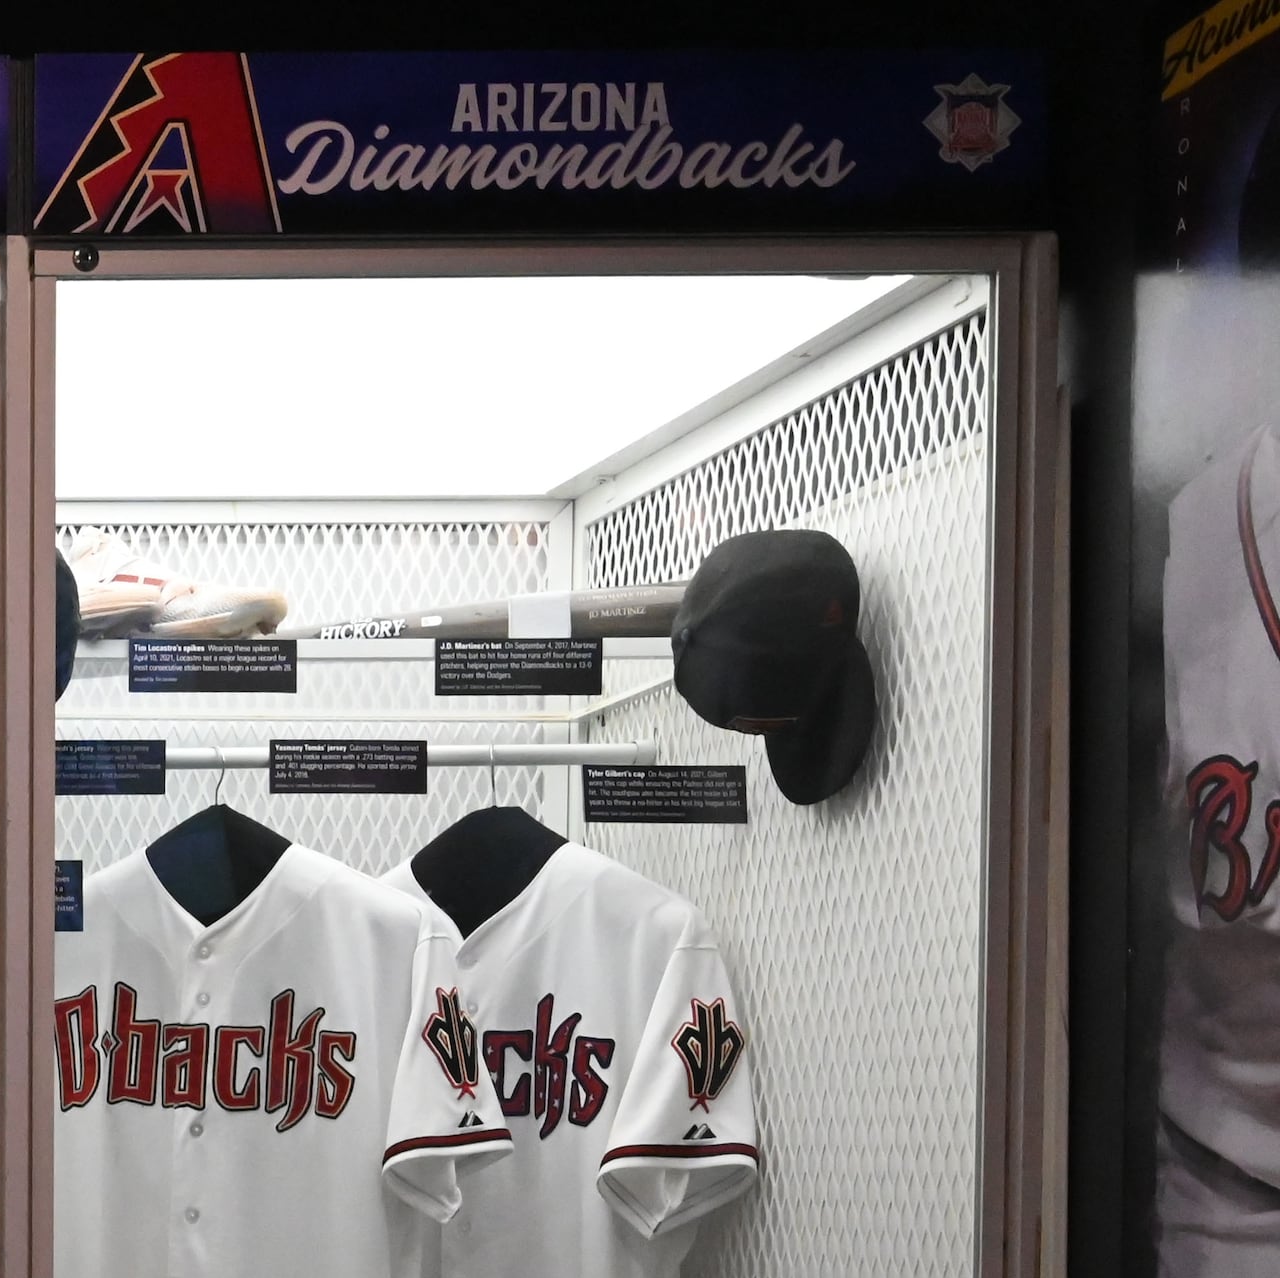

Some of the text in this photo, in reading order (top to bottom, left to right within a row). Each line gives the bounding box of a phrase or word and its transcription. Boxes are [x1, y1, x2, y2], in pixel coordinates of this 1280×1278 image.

[451, 83, 669, 132] ARIZONA
[278, 120, 856, 196] Diamondbacks
[320, 619, 405, 640] HICKORY
[601, 607, 647, 619] MARTINEZ
